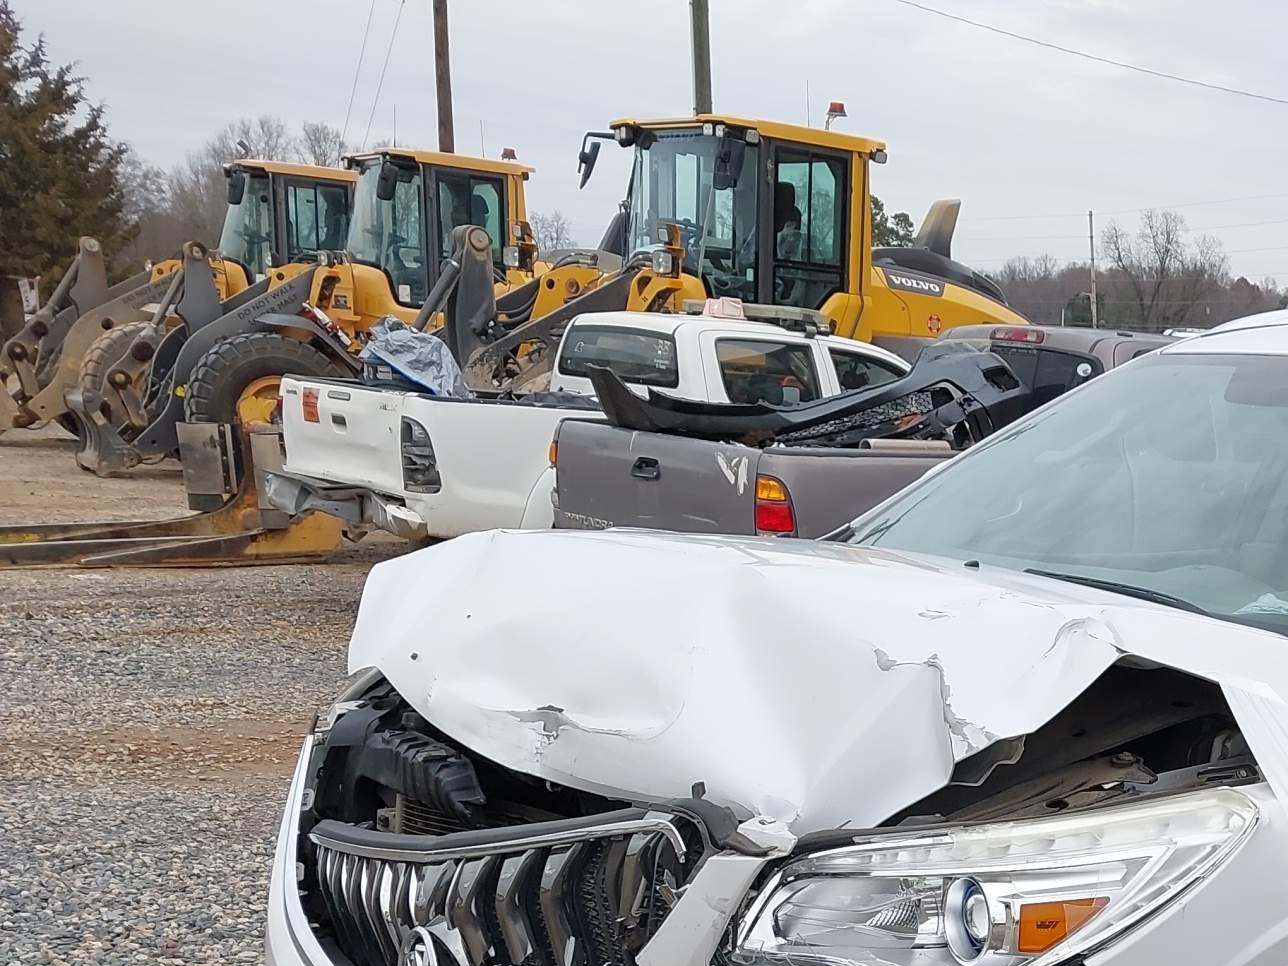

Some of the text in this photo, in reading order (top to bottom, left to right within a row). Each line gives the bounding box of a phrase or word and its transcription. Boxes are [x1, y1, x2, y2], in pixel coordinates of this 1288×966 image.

[889, 274, 940, 292] VOLVO
[238, 284, 296, 320] DO NOT WALK
[576, 514, 613, 529] TUNDRA
